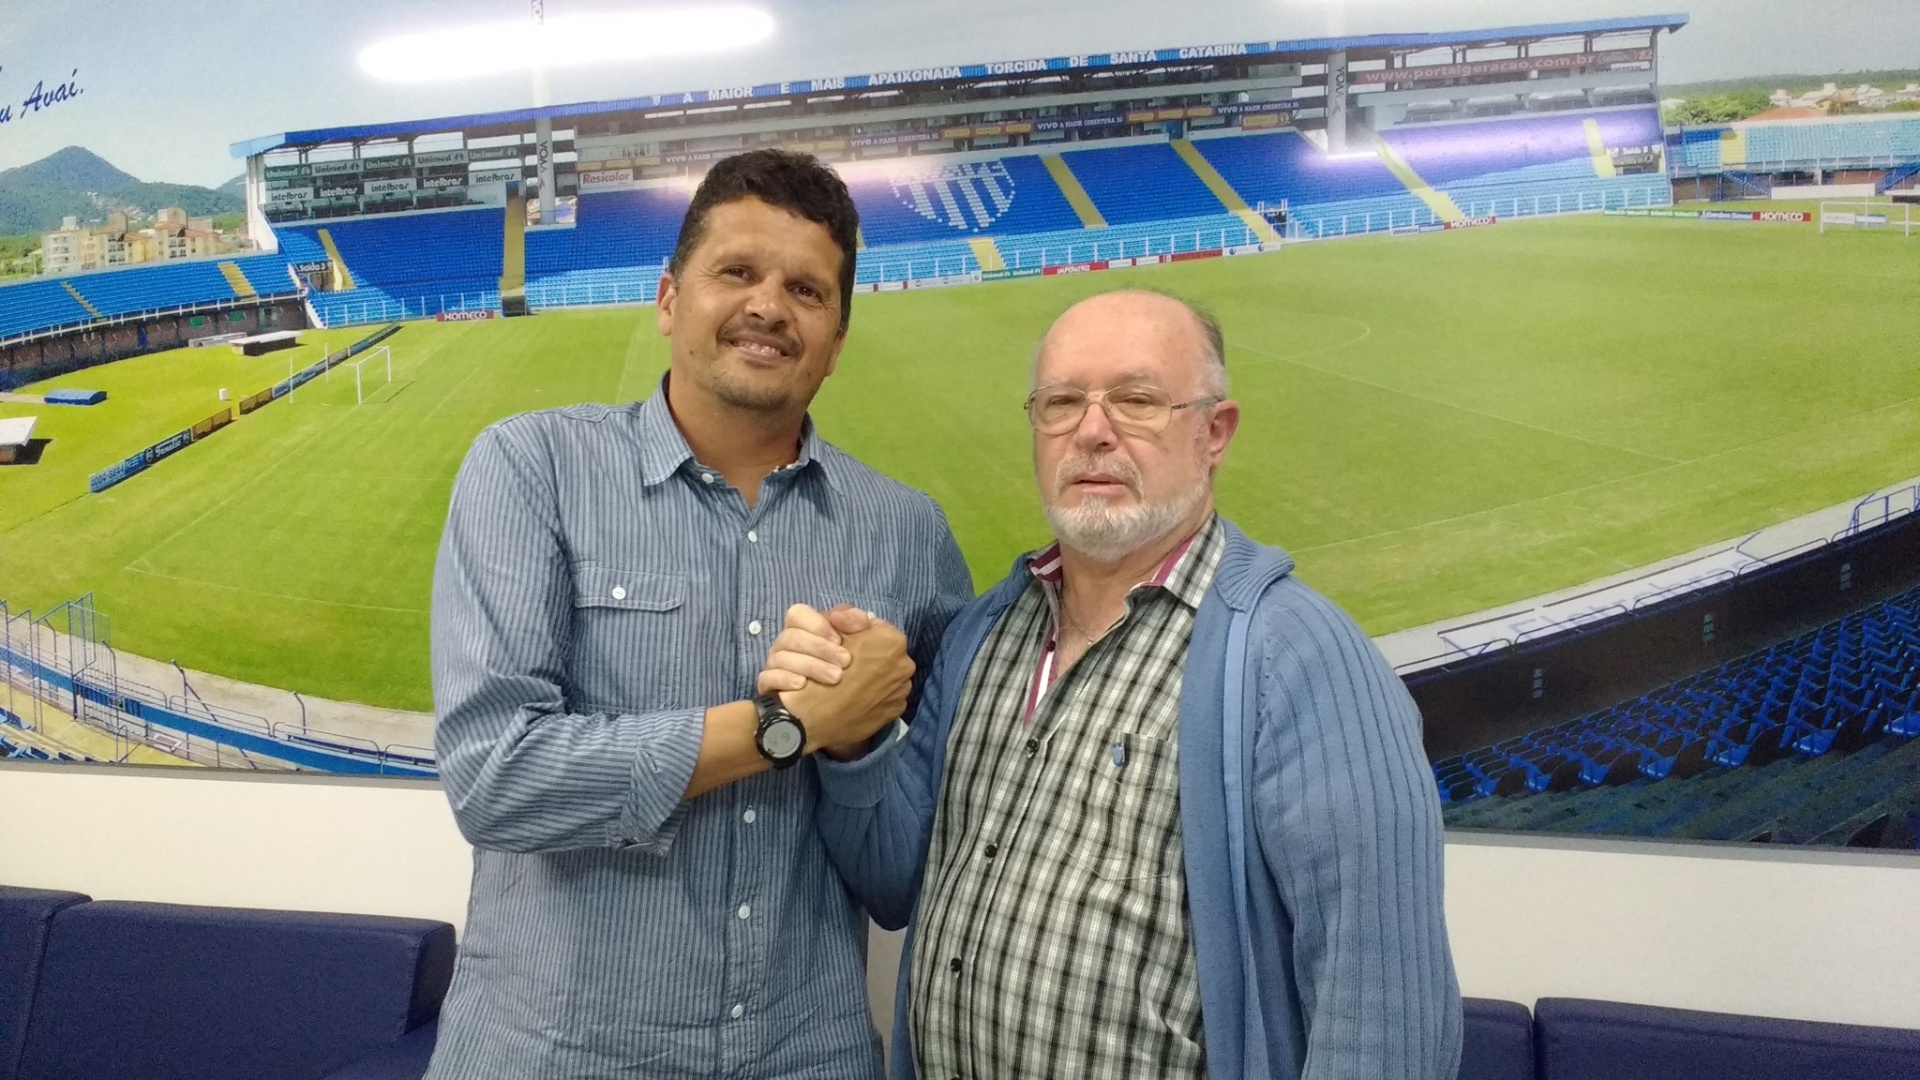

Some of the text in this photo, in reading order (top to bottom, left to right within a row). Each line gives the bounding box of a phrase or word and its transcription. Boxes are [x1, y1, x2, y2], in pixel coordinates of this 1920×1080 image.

[683, 43, 1247, 104] A MAIOR E MAIS APAIXONADA TORCIDA DE SANTA CATARINA
[20, 68, 84, 120] Avaí.
[851, 139, 872, 147] VIVO
[366, 157, 399, 169] Unimed
[418, 153, 452, 165] Unimed
[665, 154, 687, 163] VIVO
[314, 163, 347, 174] Unimed
[423, 178, 463, 188] intelbras
[475, 173, 516, 184] intelbras
[582, 171, 631, 184] Resicolor
[319, 186, 359, 198] intelbras
[371, 182, 410, 193] intelbras
[271, 191, 308, 202] intelbras
[443, 311, 488, 322] KOMECO
